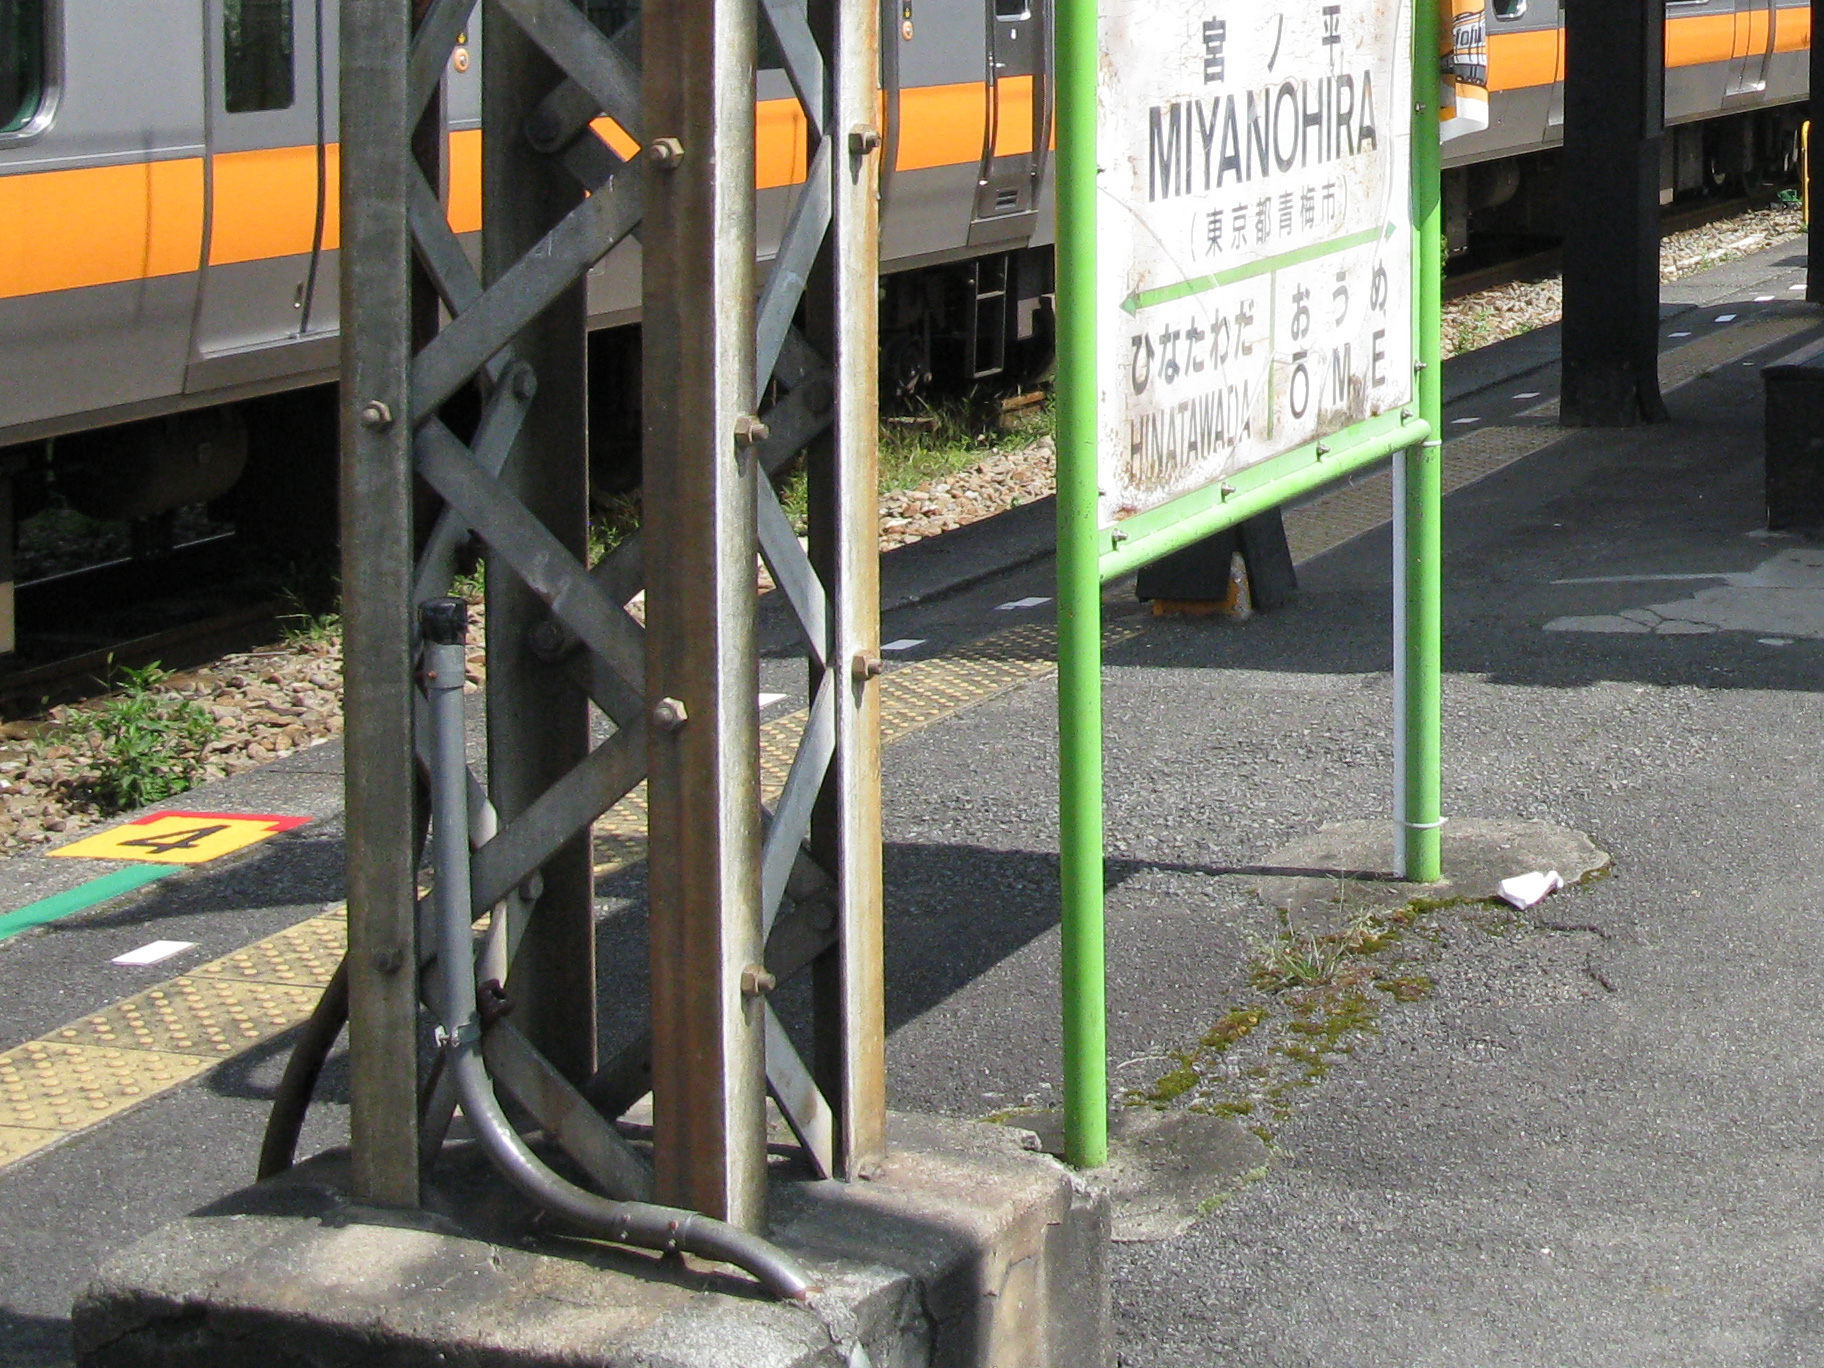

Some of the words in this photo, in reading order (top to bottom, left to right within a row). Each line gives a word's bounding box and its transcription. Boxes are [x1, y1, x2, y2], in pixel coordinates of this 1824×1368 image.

[1202, 4, 1342, 86] 宮ノ平
[1148, 69, 1378, 203] MIYANOHIRA
[1290, 258, 1389, 341] おうめ
[1130, 298, 1256, 397] ひなたわだ
[1129, 378, 1252, 475] HINATAWADA
[116, 824, 232, 855] 4
